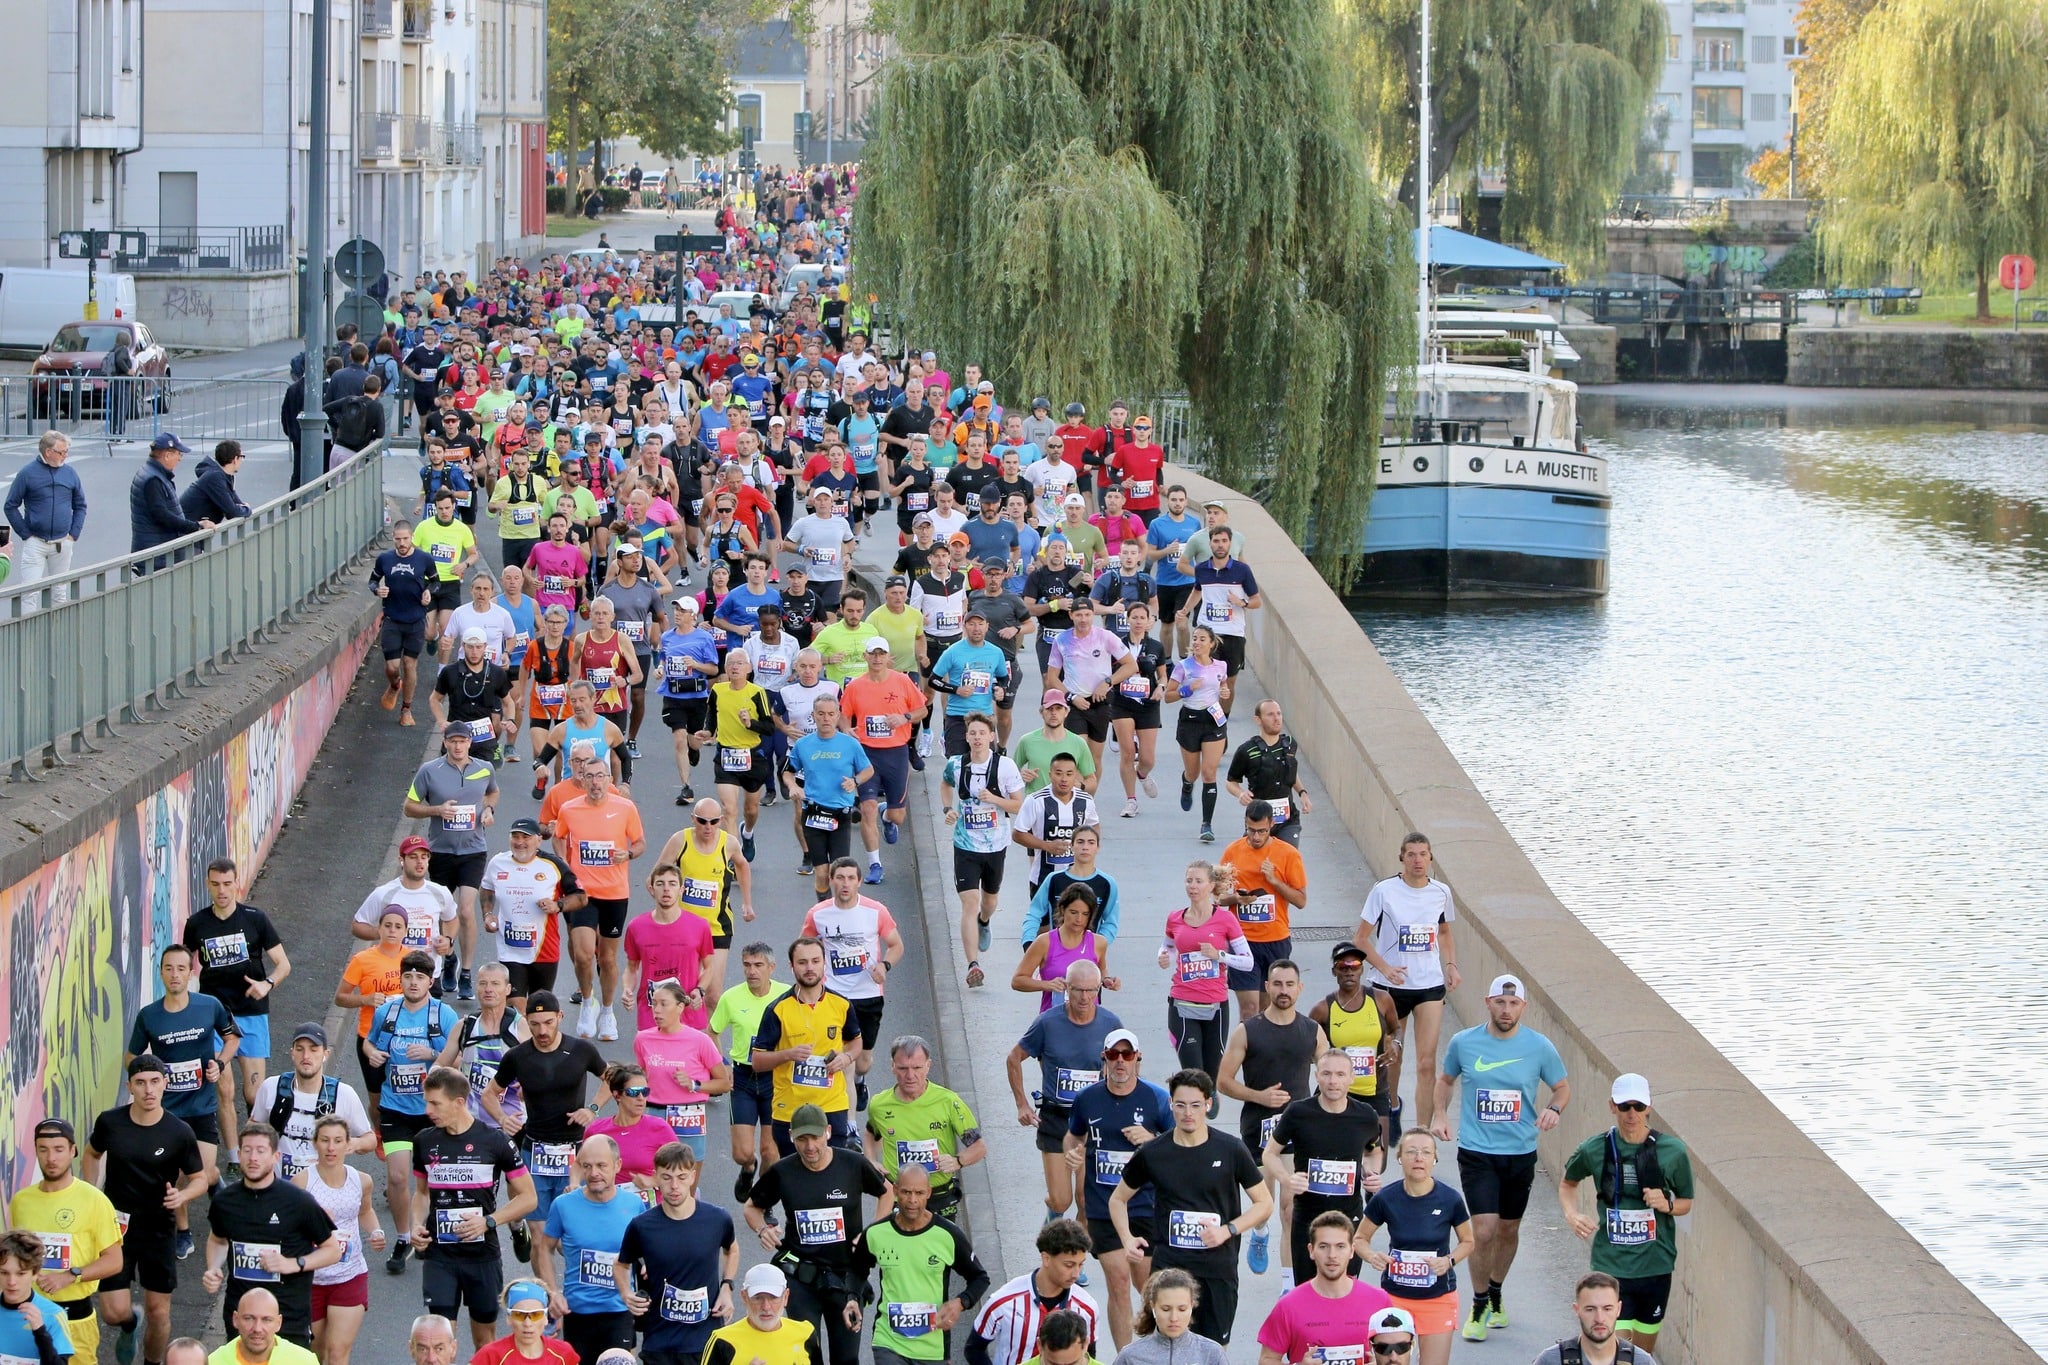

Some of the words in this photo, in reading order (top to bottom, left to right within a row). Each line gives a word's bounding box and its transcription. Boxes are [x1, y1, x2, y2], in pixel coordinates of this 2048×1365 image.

[1505, 459, 1527, 474] LA
[1538, 461, 1598, 482] MUSETTE
[472, 726, 489, 736] 1990
[966, 812, 992, 823] 11885
[1049, 827, 1074, 838] Jee
[582, 850, 610, 860] 11744
[685, 886, 712, 900] 12039
[1240, 904, 1268, 914] 11674
[506, 930, 532, 941] 11995
[1402, 933, 1430, 944] 11599
[832, 956, 861, 968] 12178
[1184, 961, 1212, 973] 13760
[158, 1028, 205, 1041] semi-marathon
[176, 1034, 199, 1044] nantes
[391, 1074, 420, 1086] 11957
[802, 1077, 820, 1085] Jonas
[1480, 1100, 1514, 1112] 11670
[670, 1116, 701, 1127] 12733
[1481, 1112, 1512, 1122] Benjamin
[535, 1154, 569, 1166] 11764
[901, 1151, 933, 1163] 12223
[1098, 1162, 1125, 1176] 1773
[1312, 1171, 1348, 1185] 12294
[800, 1220, 836, 1235] 11769
[1173, 1223, 1204, 1237] 1329
[1611, 1221, 1648, 1234] 11546
[236, 1255, 261, 1269] 1762
[584, 1262, 613, 1277] 1098
[1393, 1263, 1429, 1276] 13850
[664, 1299, 702, 1313] 13403
[892, 1314, 929, 1328] 12351
